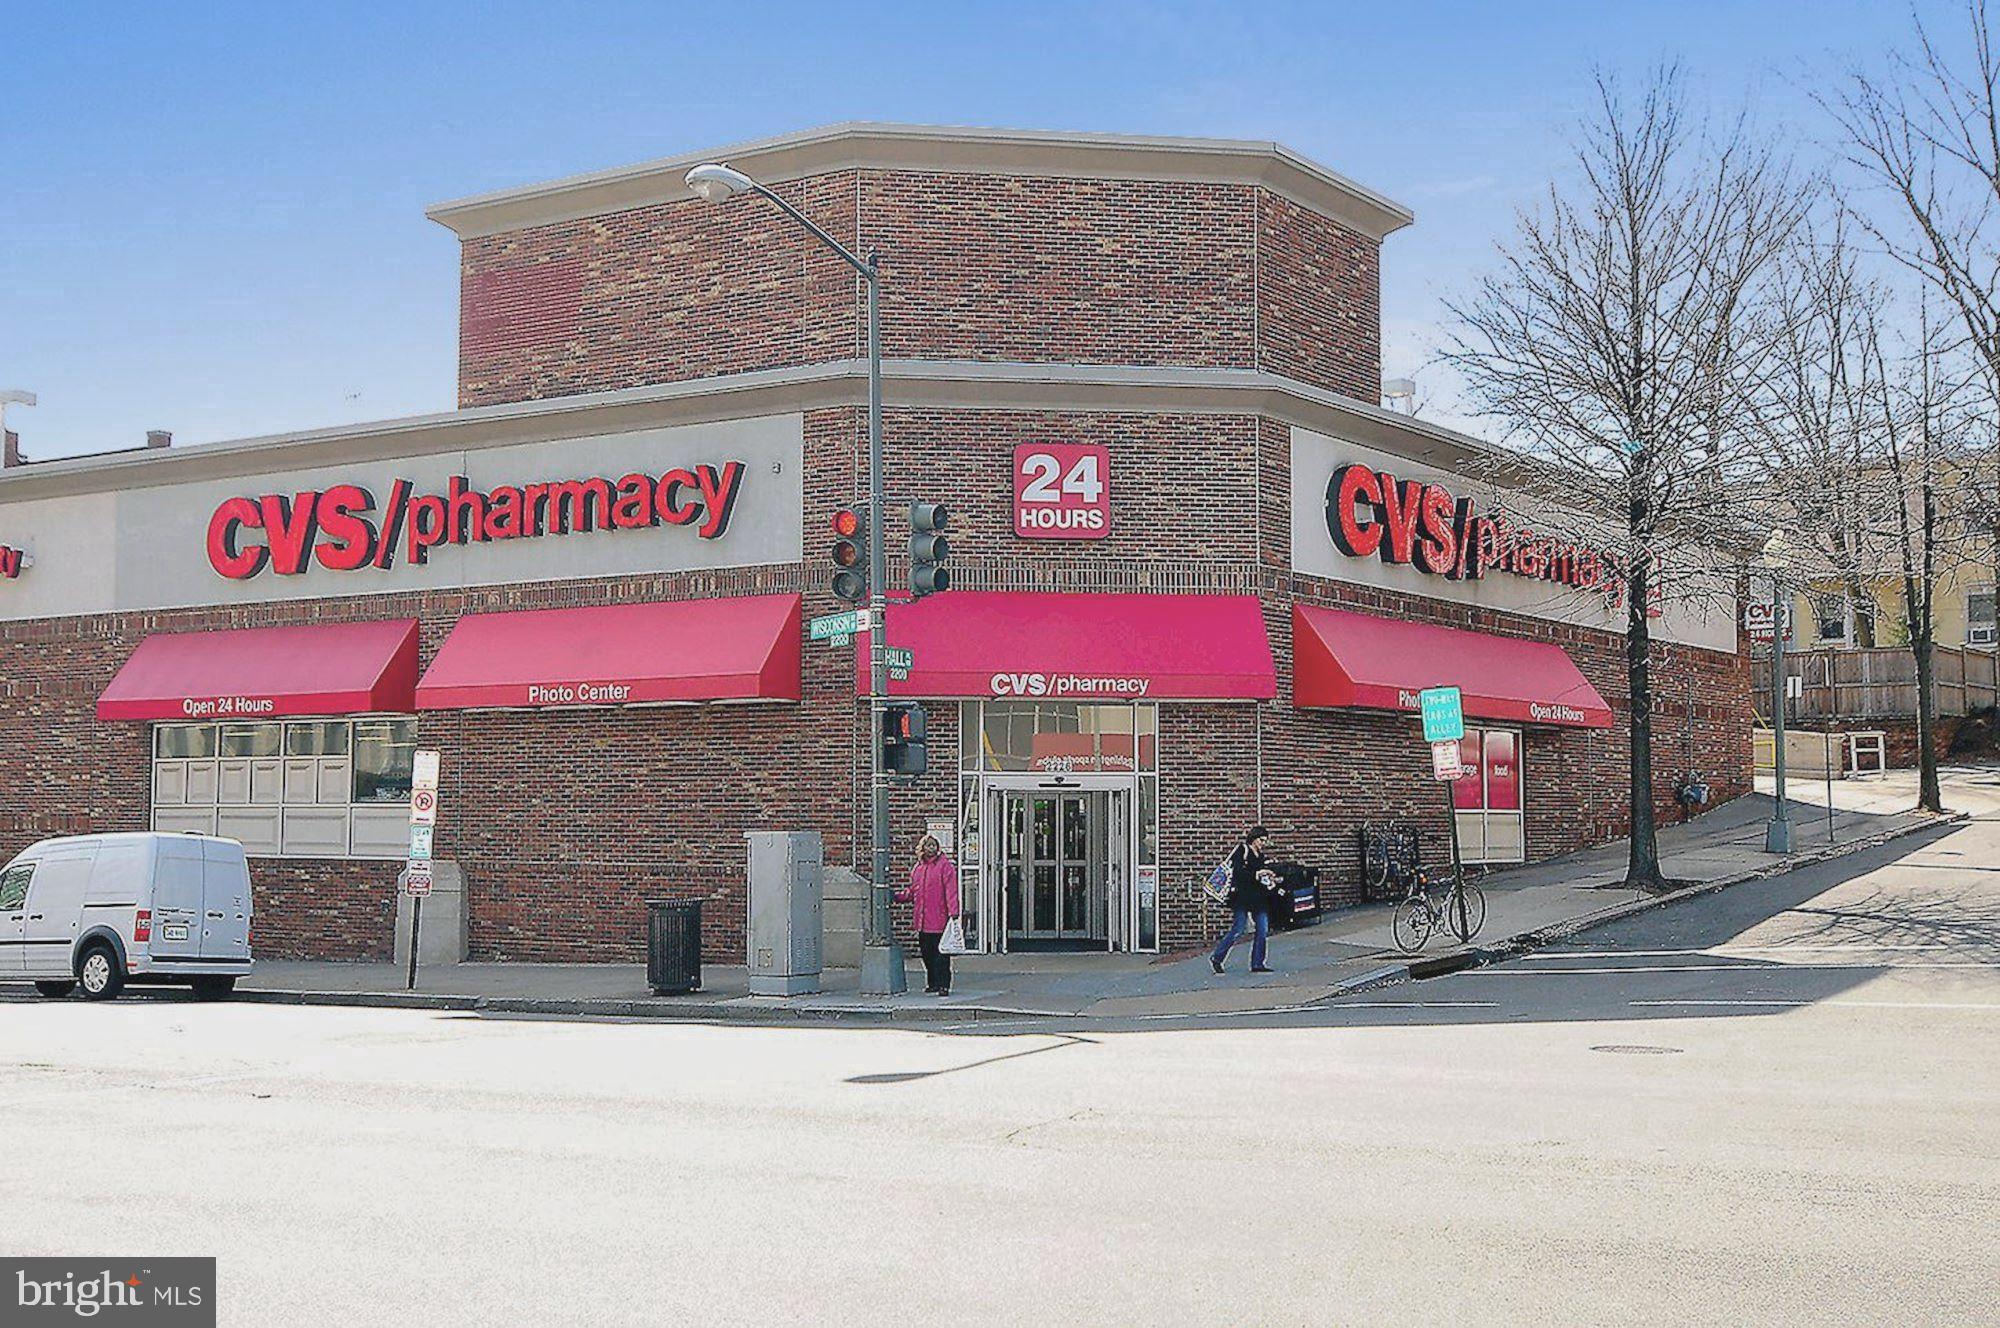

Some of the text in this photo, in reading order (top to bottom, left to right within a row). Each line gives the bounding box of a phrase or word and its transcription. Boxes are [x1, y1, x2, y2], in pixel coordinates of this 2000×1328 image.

[1021, 453, 1103, 503] 24
[207, 461, 746, 579] CVS/pharmacy
[1021, 508, 1104, 529] HOURS
[528, 683, 631, 702] Photo Center
[990, 673, 1149, 695] CVS/pharmacy
[183, 696, 274, 717] Open 24 Hours
[1530, 702, 1585, 722] Open 24 Hours
